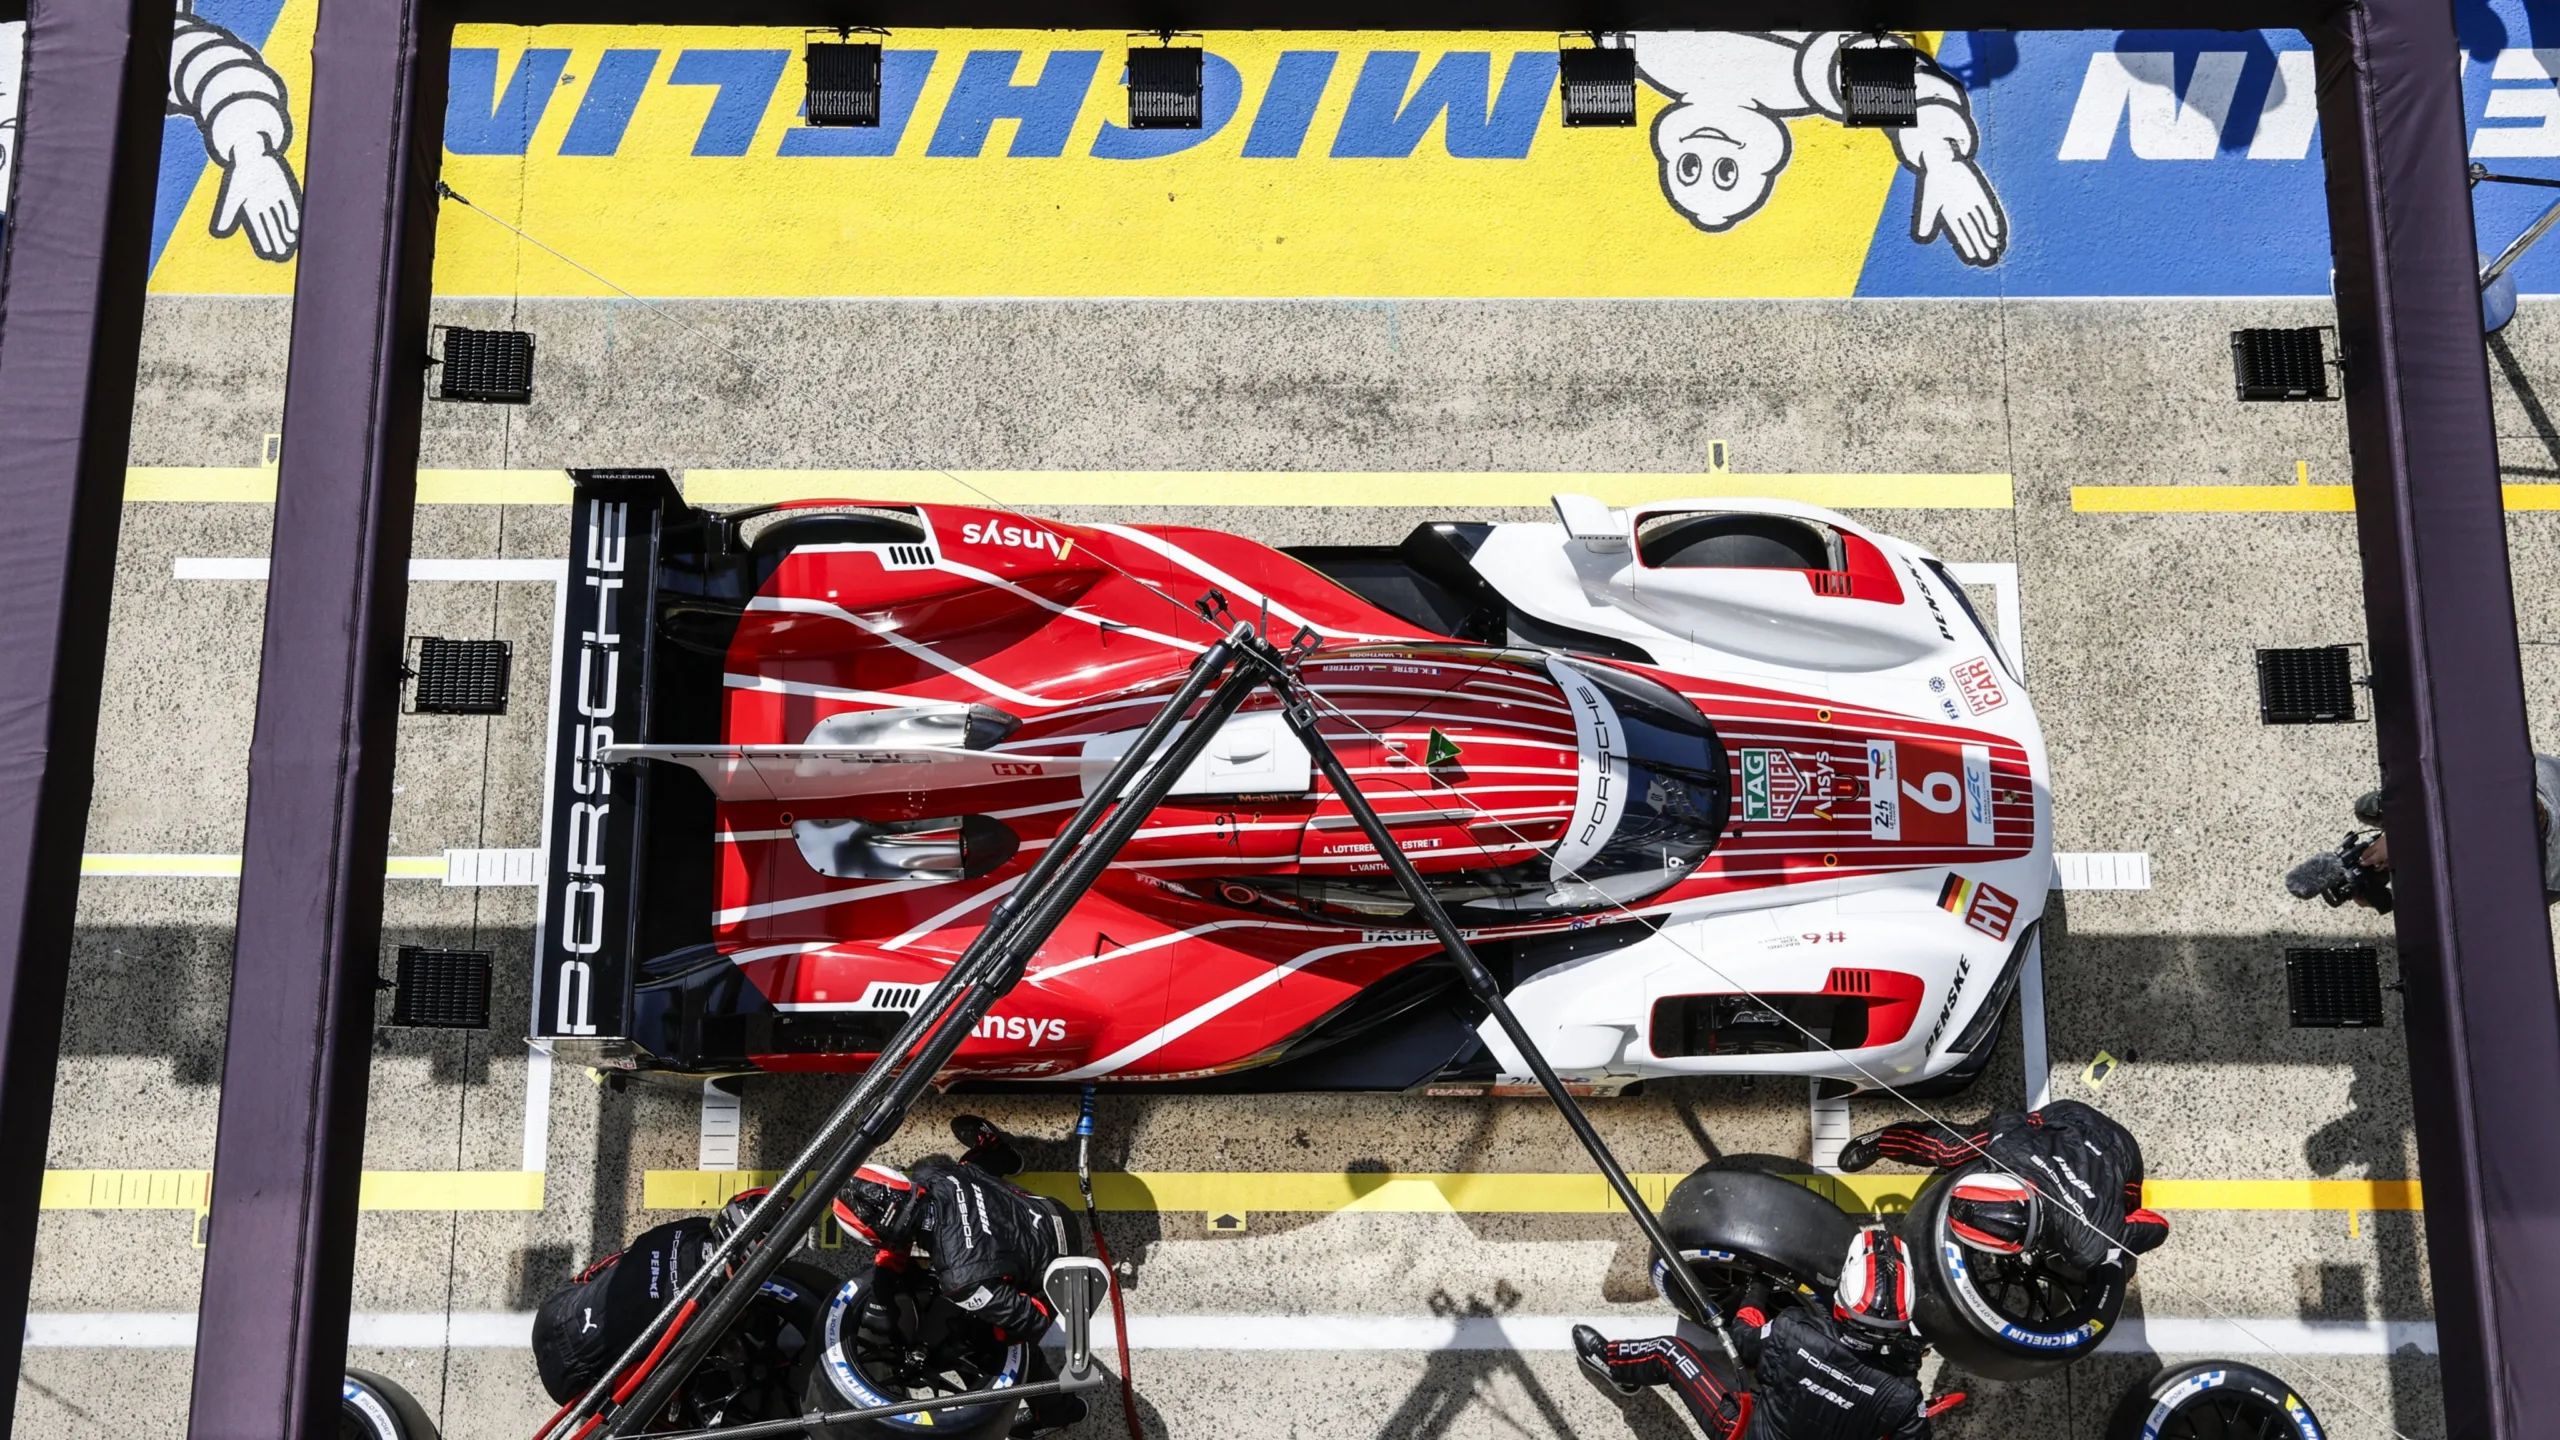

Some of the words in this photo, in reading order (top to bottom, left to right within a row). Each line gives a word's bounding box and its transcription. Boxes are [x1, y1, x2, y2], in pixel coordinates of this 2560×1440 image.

[962, 519, 1075, 561] Ansys
[1956, 666, 1986, 715] HYPER
[1968, 660, 2003, 708] CAR
[557, 498, 628, 1035] PORSCHE
[994, 764, 1037, 775] HY
[1580, 685, 1609, 847] PORSCHE
[1746, 755, 1765, 816] TAG
[1770, 753, 1800, 817] HEUER
[1813, 750, 1834, 822] Ansys
[1901, 771, 1962, 814] 6
[1966, 766, 1982, 823] WEC
[1323, 846, 1332, 854] A.
[1402, 838, 1429, 849] ESTRE
[1350, 863, 1358, 872] L.
[1968, 883, 2015, 940] HY
[1924, 953, 1971, 1057] PENSKE
[947, 1174, 974, 1249] PORSCHE
[970, 1182, 993, 1236] PENSKE
[1619, 1337, 1700, 1380] PORSCHE
[2007, 1327, 2079, 1348] MICHELIN
[1796, 1347, 1876, 1397] PORSCHE
